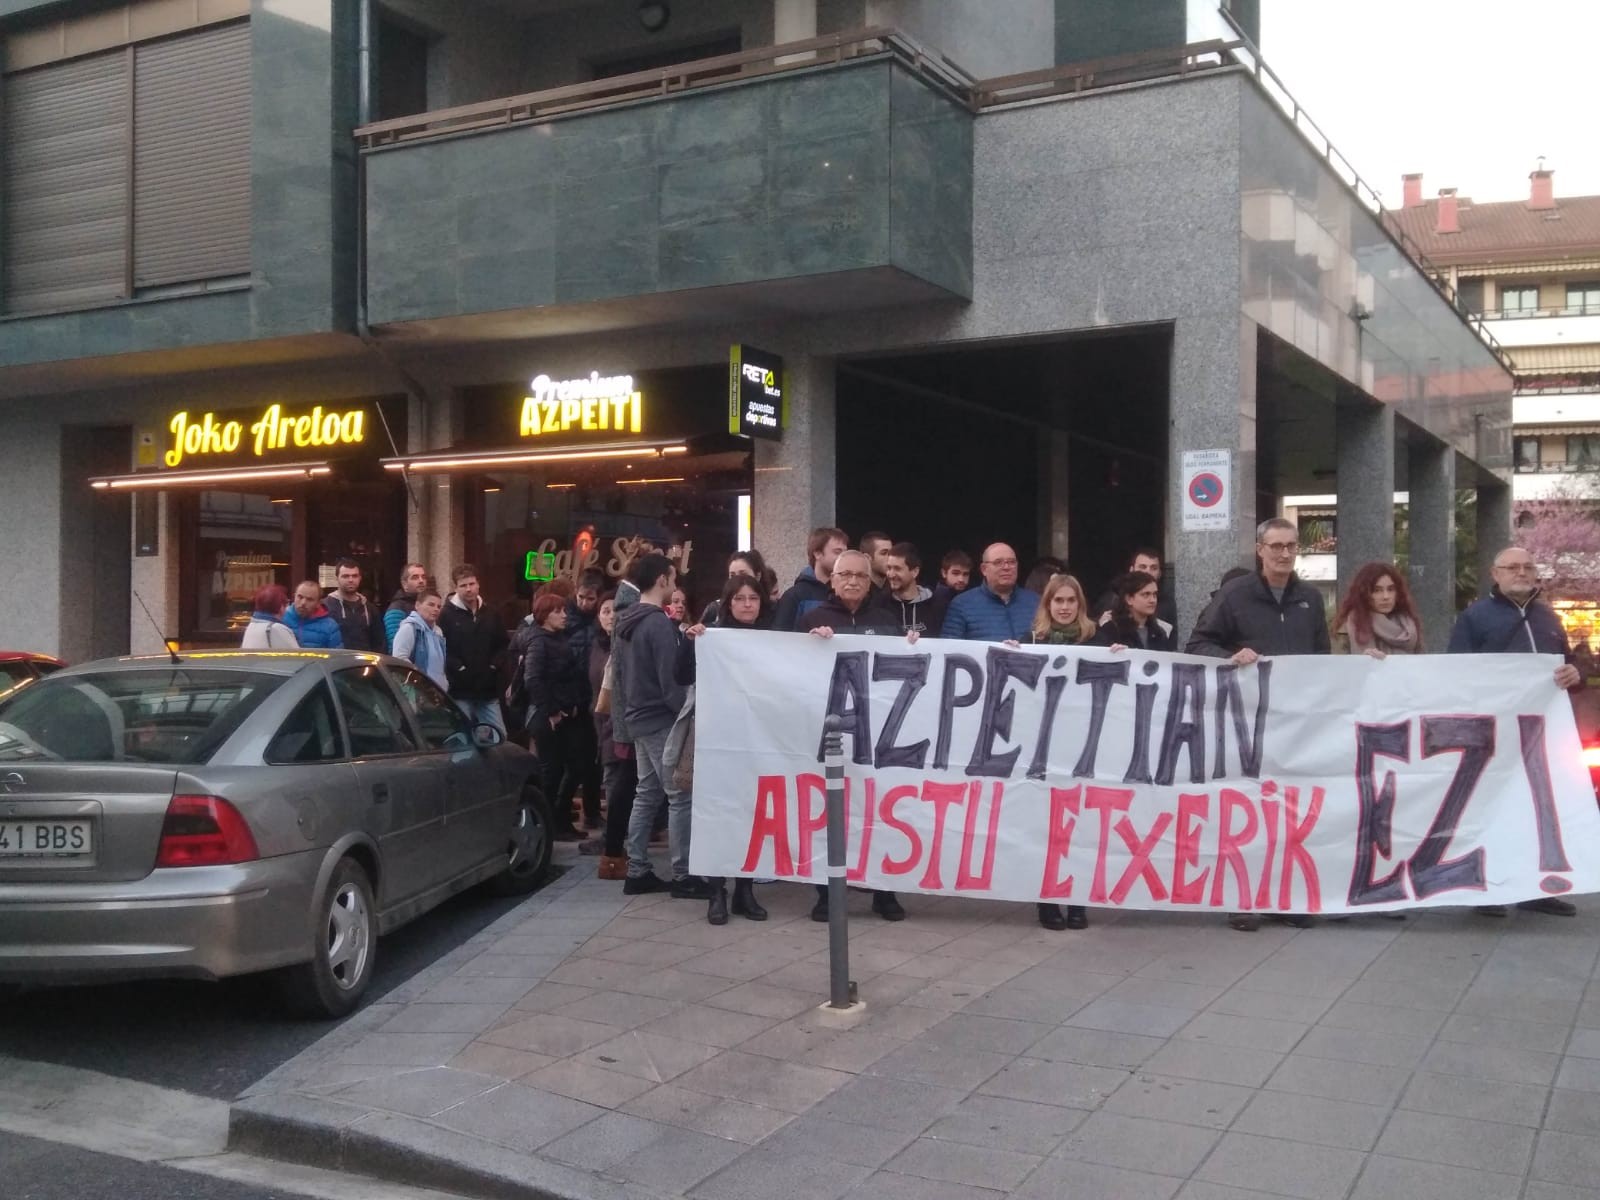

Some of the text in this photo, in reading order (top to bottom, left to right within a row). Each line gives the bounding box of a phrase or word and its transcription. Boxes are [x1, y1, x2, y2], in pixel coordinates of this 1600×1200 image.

[531, 371, 633, 404] Premium
[520, 391, 641, 436] AZPEITI
[746, 411, 777, 427] deportivas
[748, 401, 775, 415] apuestas
[165, 404, 364, 467] Joko Aretoa
[36, 825, 84, 849] BBS
[740, 772, 1004, 891] APUSTU
